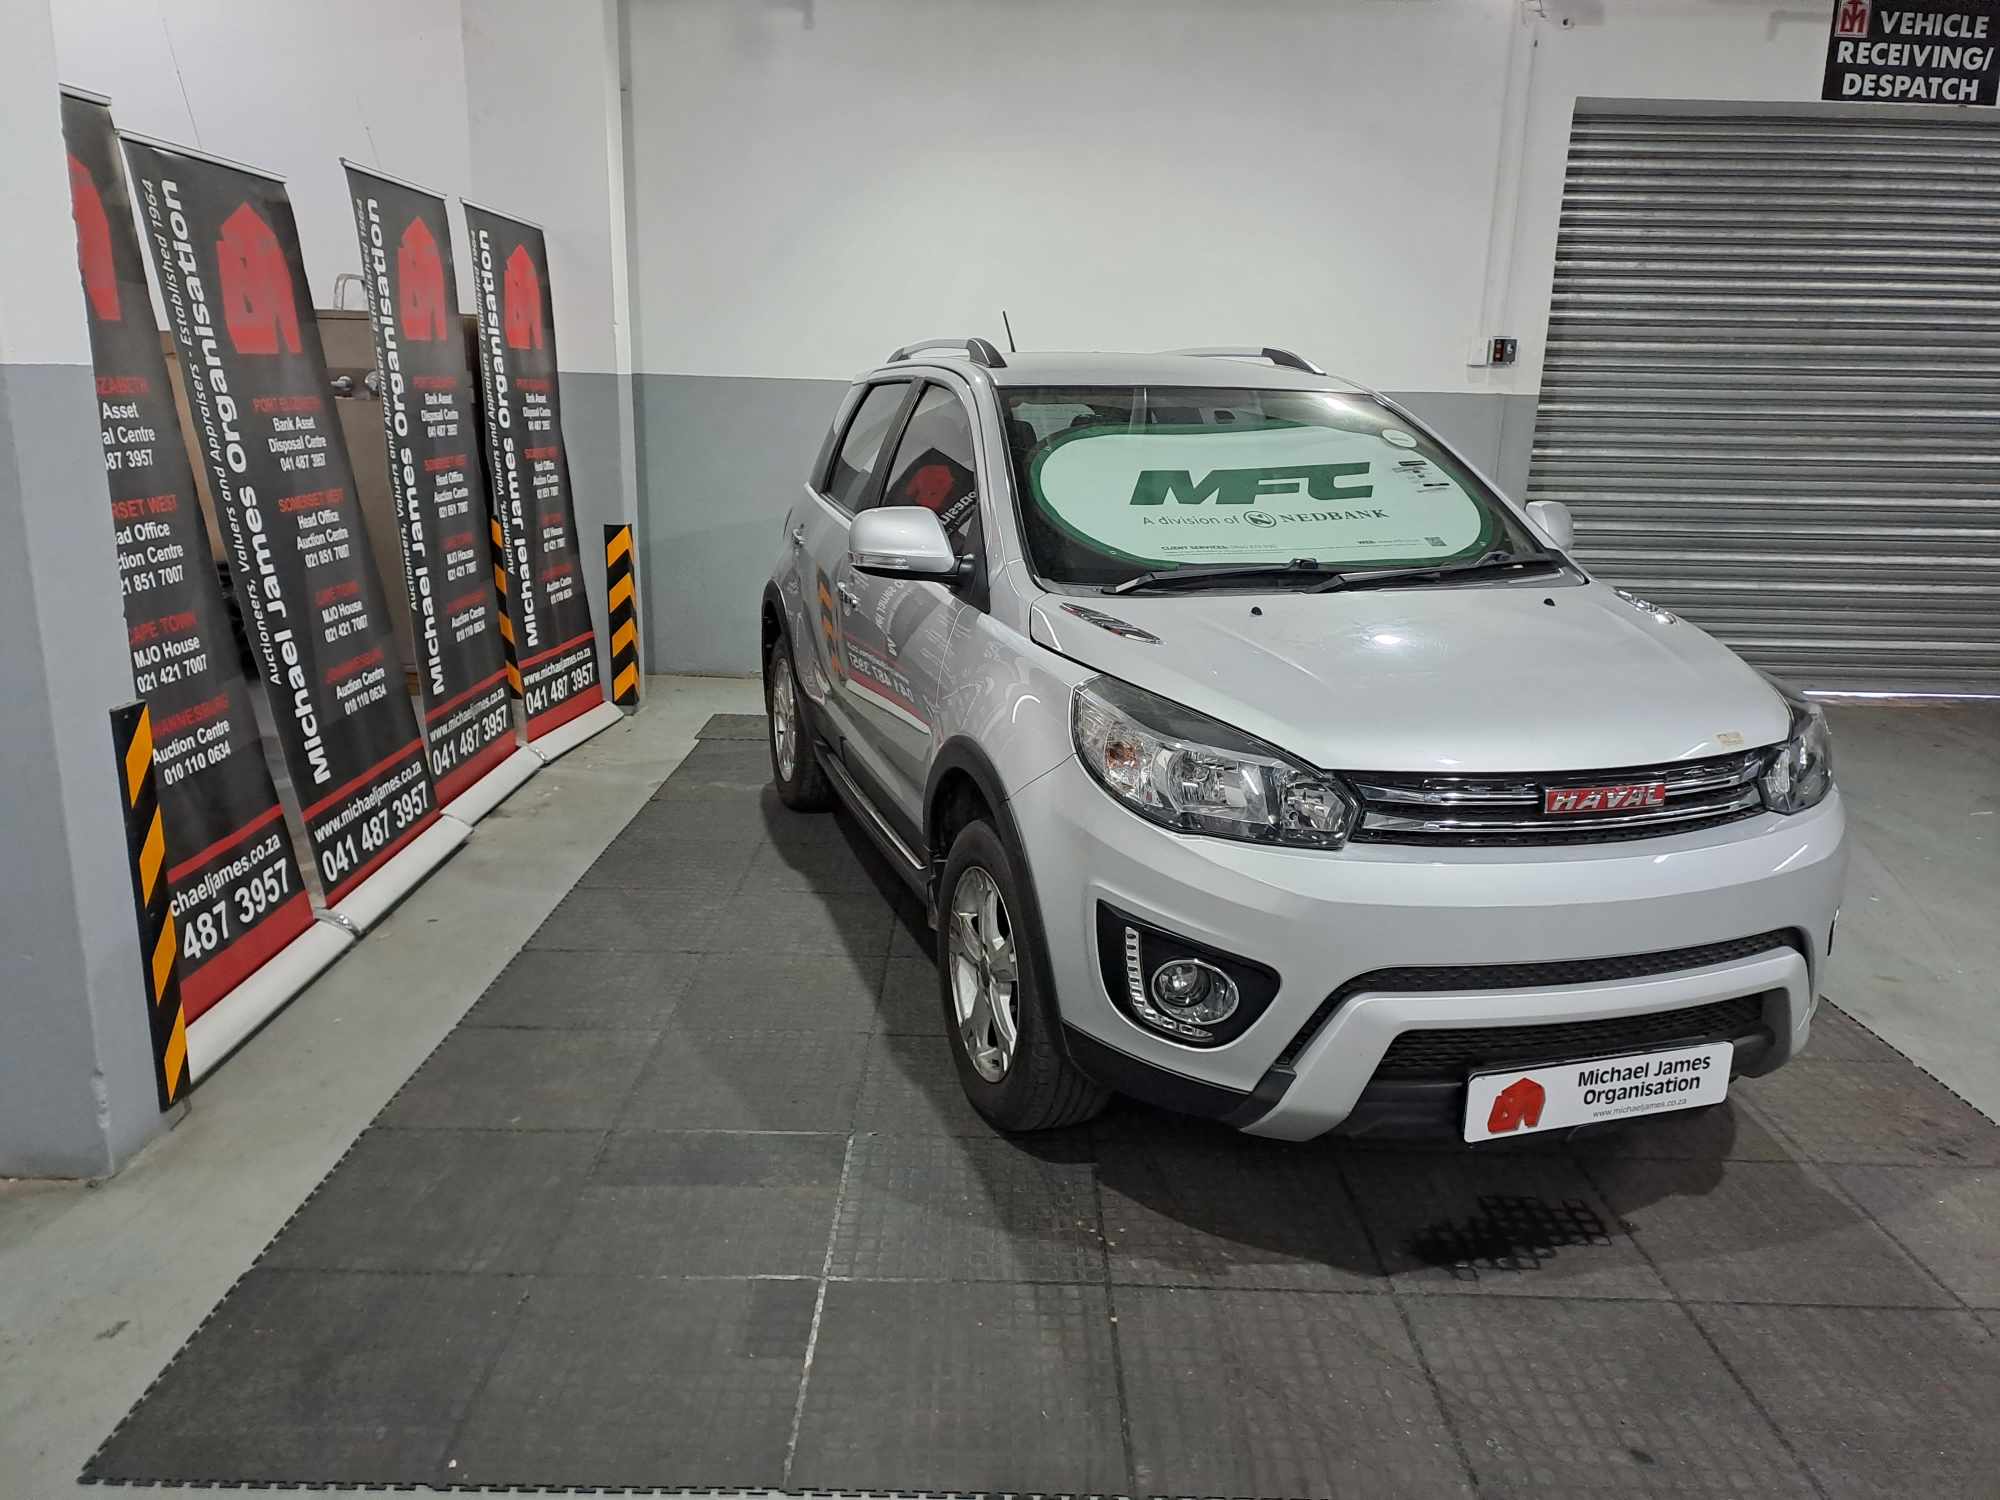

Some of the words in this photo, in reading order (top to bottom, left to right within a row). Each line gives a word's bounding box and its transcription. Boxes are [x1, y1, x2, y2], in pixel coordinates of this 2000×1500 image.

[1880, 10, 1990, 39] VEHICLE
[1837, 41, 1994, 71] RECEIVING/
[1842, 73, 1979, 101] DESPATCH
[142, 179, 162, 228] 1964
[154, 233, 193, 346] Established
[161, 179, 247, 475] Organisation
[367, 198, 408, 437] Organisation
[479, 230, 510, 429] Organisation
[102, 402, 139, 419] Asset
[190, 364, 223, 462] Appraisers
[272, 417, 295, 431] Bank
[117, 426, 156, 443] Centre
[268, 437, 304, 454] Disposal
[387, 429, 397, 459] and
[126, 449, 153, 468] 3957
[280, 456, 295, 472] 041
[213, 466, 232, 501] and
[503, 437, 524, 530] James
[1130, 461, 1373, 506] MFC
[147, 494, 176, 514] WEST
[401, 447, 426, 557] James
[1143, 516, 1154, 526] A
[1159, 514, 1221, 526] division
[1224, 514, 1240, 525] of
[1279, 509, 1390, 523] NEDBANK
[134, 521, 171, 542] Office
[297, 512, 317, 530] Head
[317, 509, 340, 525] Office
[147, 543, 185, 564] Centre
[227, 506, 250, 573] Valuers
[239, 486, 287, 619] James
[296, 531, 326, 551] Auction
[326, 527, 349, 543] Centre
[305, 552, 319, 569] 021
[319, 549, 334, 565] 851
[133, 571, 157, 592] 851
[158, 564, 184, 586] 7007
[514, 538, 539, 647] Michael
[338, 600, 363, 616] House
[324, 627, 339, 643] 021
[338, 621, 352, 638] 421
[414, 566, 445, 695] Michael
[133, 644, 161, 669] MJO
[162, 635, 201, 660] House
[136, 671, 158, 694] 021
[160, 663, 182, 685] 421
[183, 653, 208, 677] 7007
[336, 679, 362, 700] Auction
[362, 667, 385, 686] Centre
[526, 685, 548, 715] 041
[551, 675, 568, 702] 487
[571, 662, 593, 692] 3957
[274, 629, 332, 785] Michael
[152, 736, 196, 766] Auction
[196, 718, 231, 746] Centre
[432, 739, 457, 776] 041
[460, 723, 480, 757] 487
[482, 704, 507, 742] 3957
[163, 763, 184, 786] 010
[184, 752, 206, 776] 110
[207, 740, 232, 765] 0634
[314, 760, 422, 843] www.michaeljames.co.za
[1551, 784, 1663, 811] HAVAL
[322, 834, 359, 882] 041
[362, 808, 390, 852] 487
[392, 780, 428, 829] 3957
[182, 900, 229, 961] 487
[234, 858, 290, 924] 3957
[1578, 1062, 1650, 1088] Michael
[1653, 1056, 1711, 1077] James
[1583, 1076, 1701, 1105] Organisation
[1592, 1098, 1687, 1119] www.michaeljames.co.za
